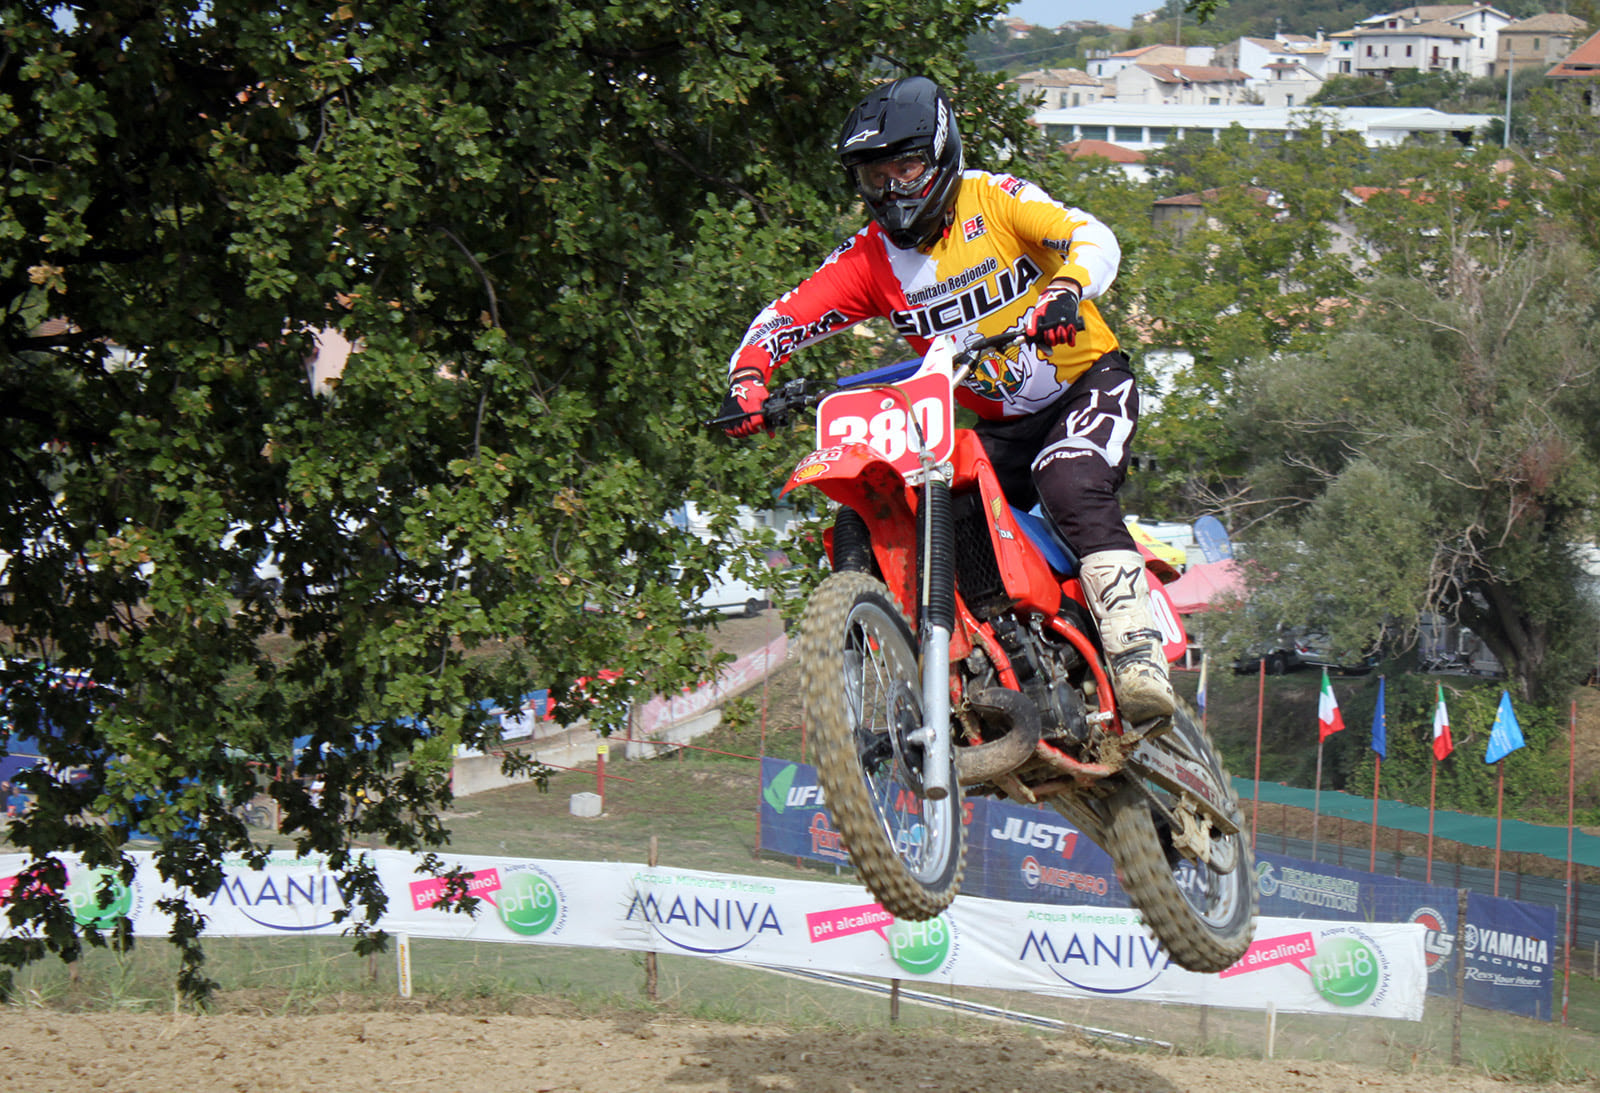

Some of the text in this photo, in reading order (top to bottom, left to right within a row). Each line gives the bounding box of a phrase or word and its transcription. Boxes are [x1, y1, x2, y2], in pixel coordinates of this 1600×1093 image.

[890, 254, 1044, 339] SICILIA
[905, 257, 998, 305] Comitato Regionale
[829, 397, 944, 463] 380
[991, 817, 1079, 860] JUST1
[416, 889, 438, 906] pH
[501, 883, 552, 922] pH8
[633, 871, 776, 895] Acqua Minerale Alcalina
[626, 890, 784, 936] MANIVA
[812, 921, 834, 938] pH
[1026, 910, 1067, 923] Acqua
[1071, 912, 1127, 925] Minerale
[892, 918, 945, 959] pH8
[1019, 929, 1175, 970] MANIV
[1247, 939, 1312, 965] alcalino!
[1479, 928, 1549, 965] YAMAHA
[1314, 947, 1373, 992] pH8
[1465, 952, 1543, 973] RACING
